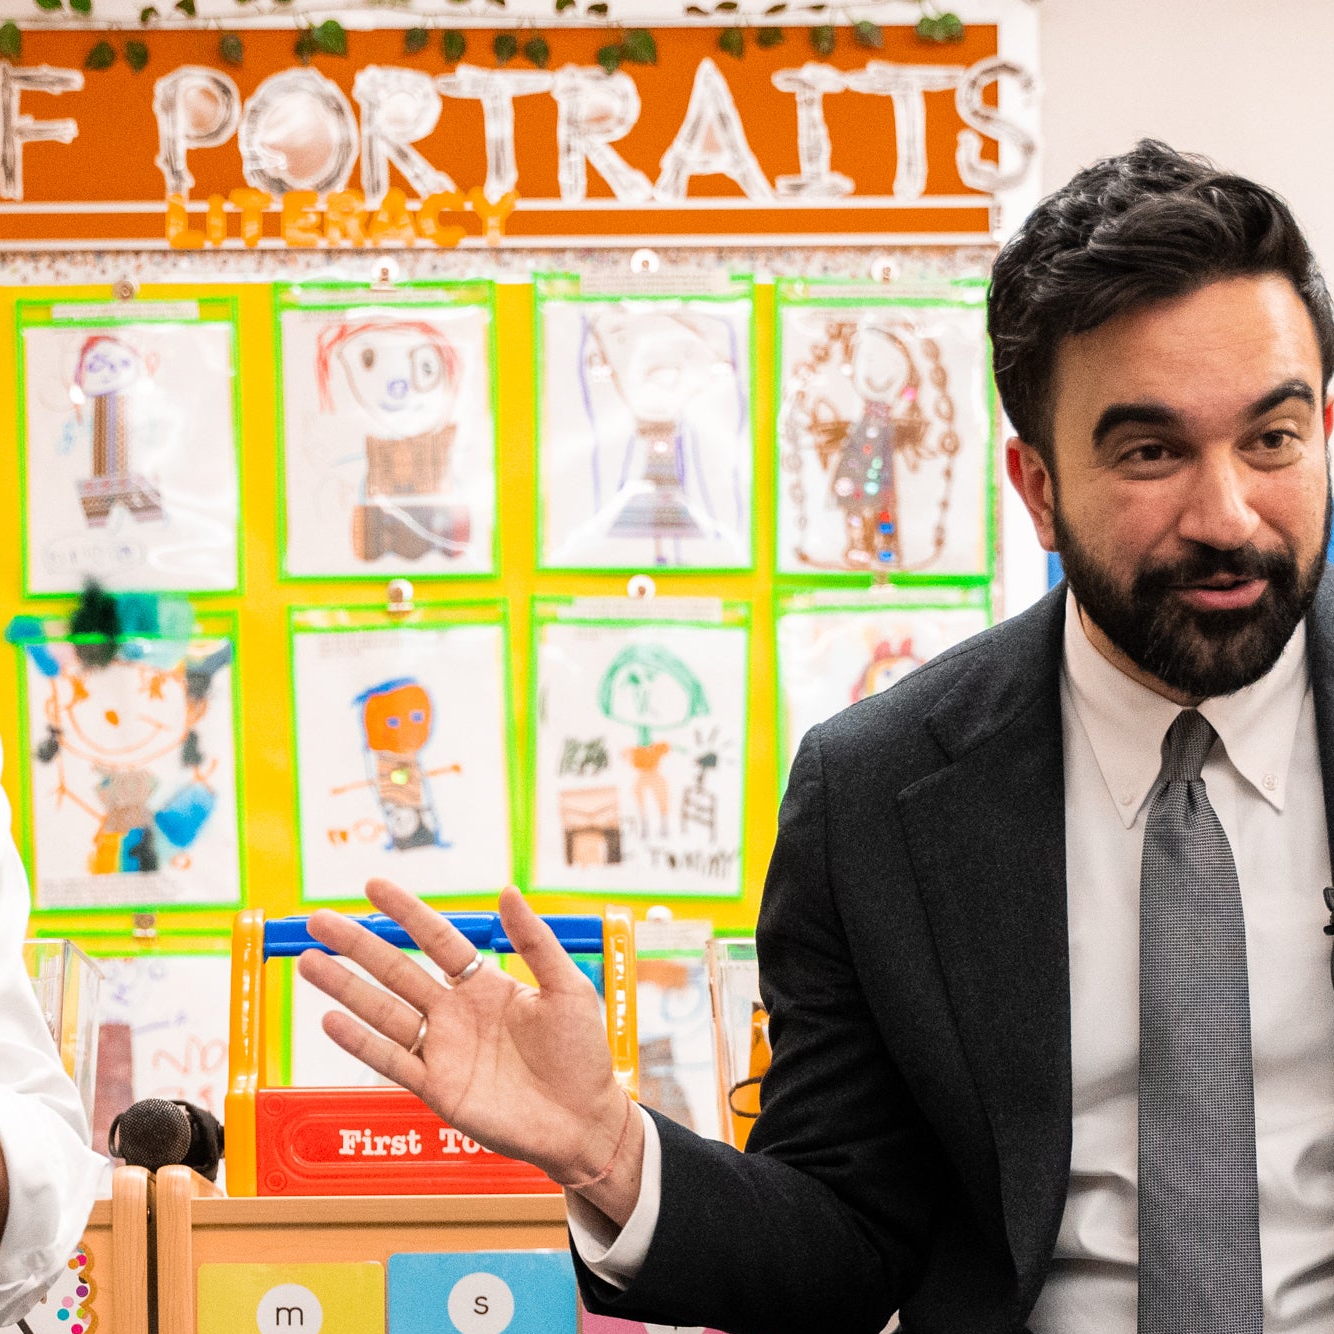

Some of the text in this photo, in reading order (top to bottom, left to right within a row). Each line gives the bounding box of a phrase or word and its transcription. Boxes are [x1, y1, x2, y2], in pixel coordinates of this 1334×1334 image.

[153, 55, 1041, 205] PORTRAITS
[166, 187, 518, 248] LITERACY
[338, 1127, 496, 1156] First To
[275, 1305, 304, 1326] m
[473, 1295, 488, 1315] s
